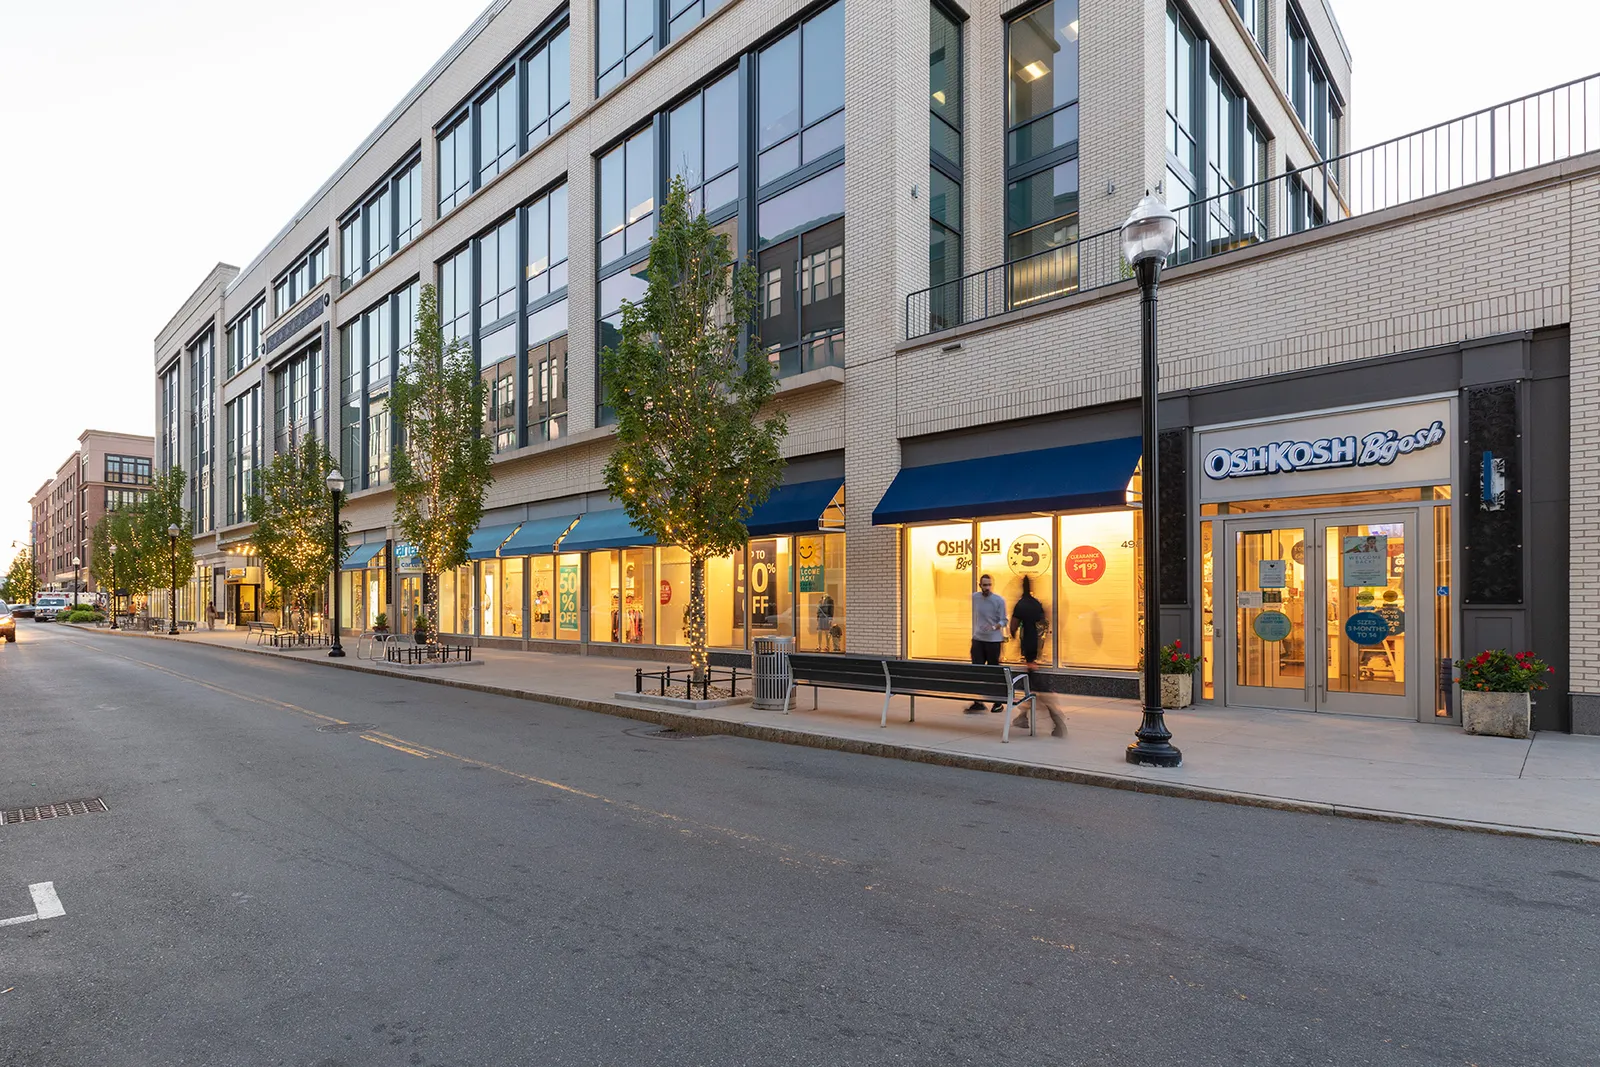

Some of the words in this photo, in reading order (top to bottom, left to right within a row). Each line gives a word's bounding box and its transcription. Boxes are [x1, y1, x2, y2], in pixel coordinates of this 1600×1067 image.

[1203, 435, 1357, 480] OSHKOSH
[956, 556, 973, 571] B'go
[1070, 552, 1100, 560] CLEARANCE
[559, 572, 577, 594] 50
[560, 611, 577, 624] OFF
